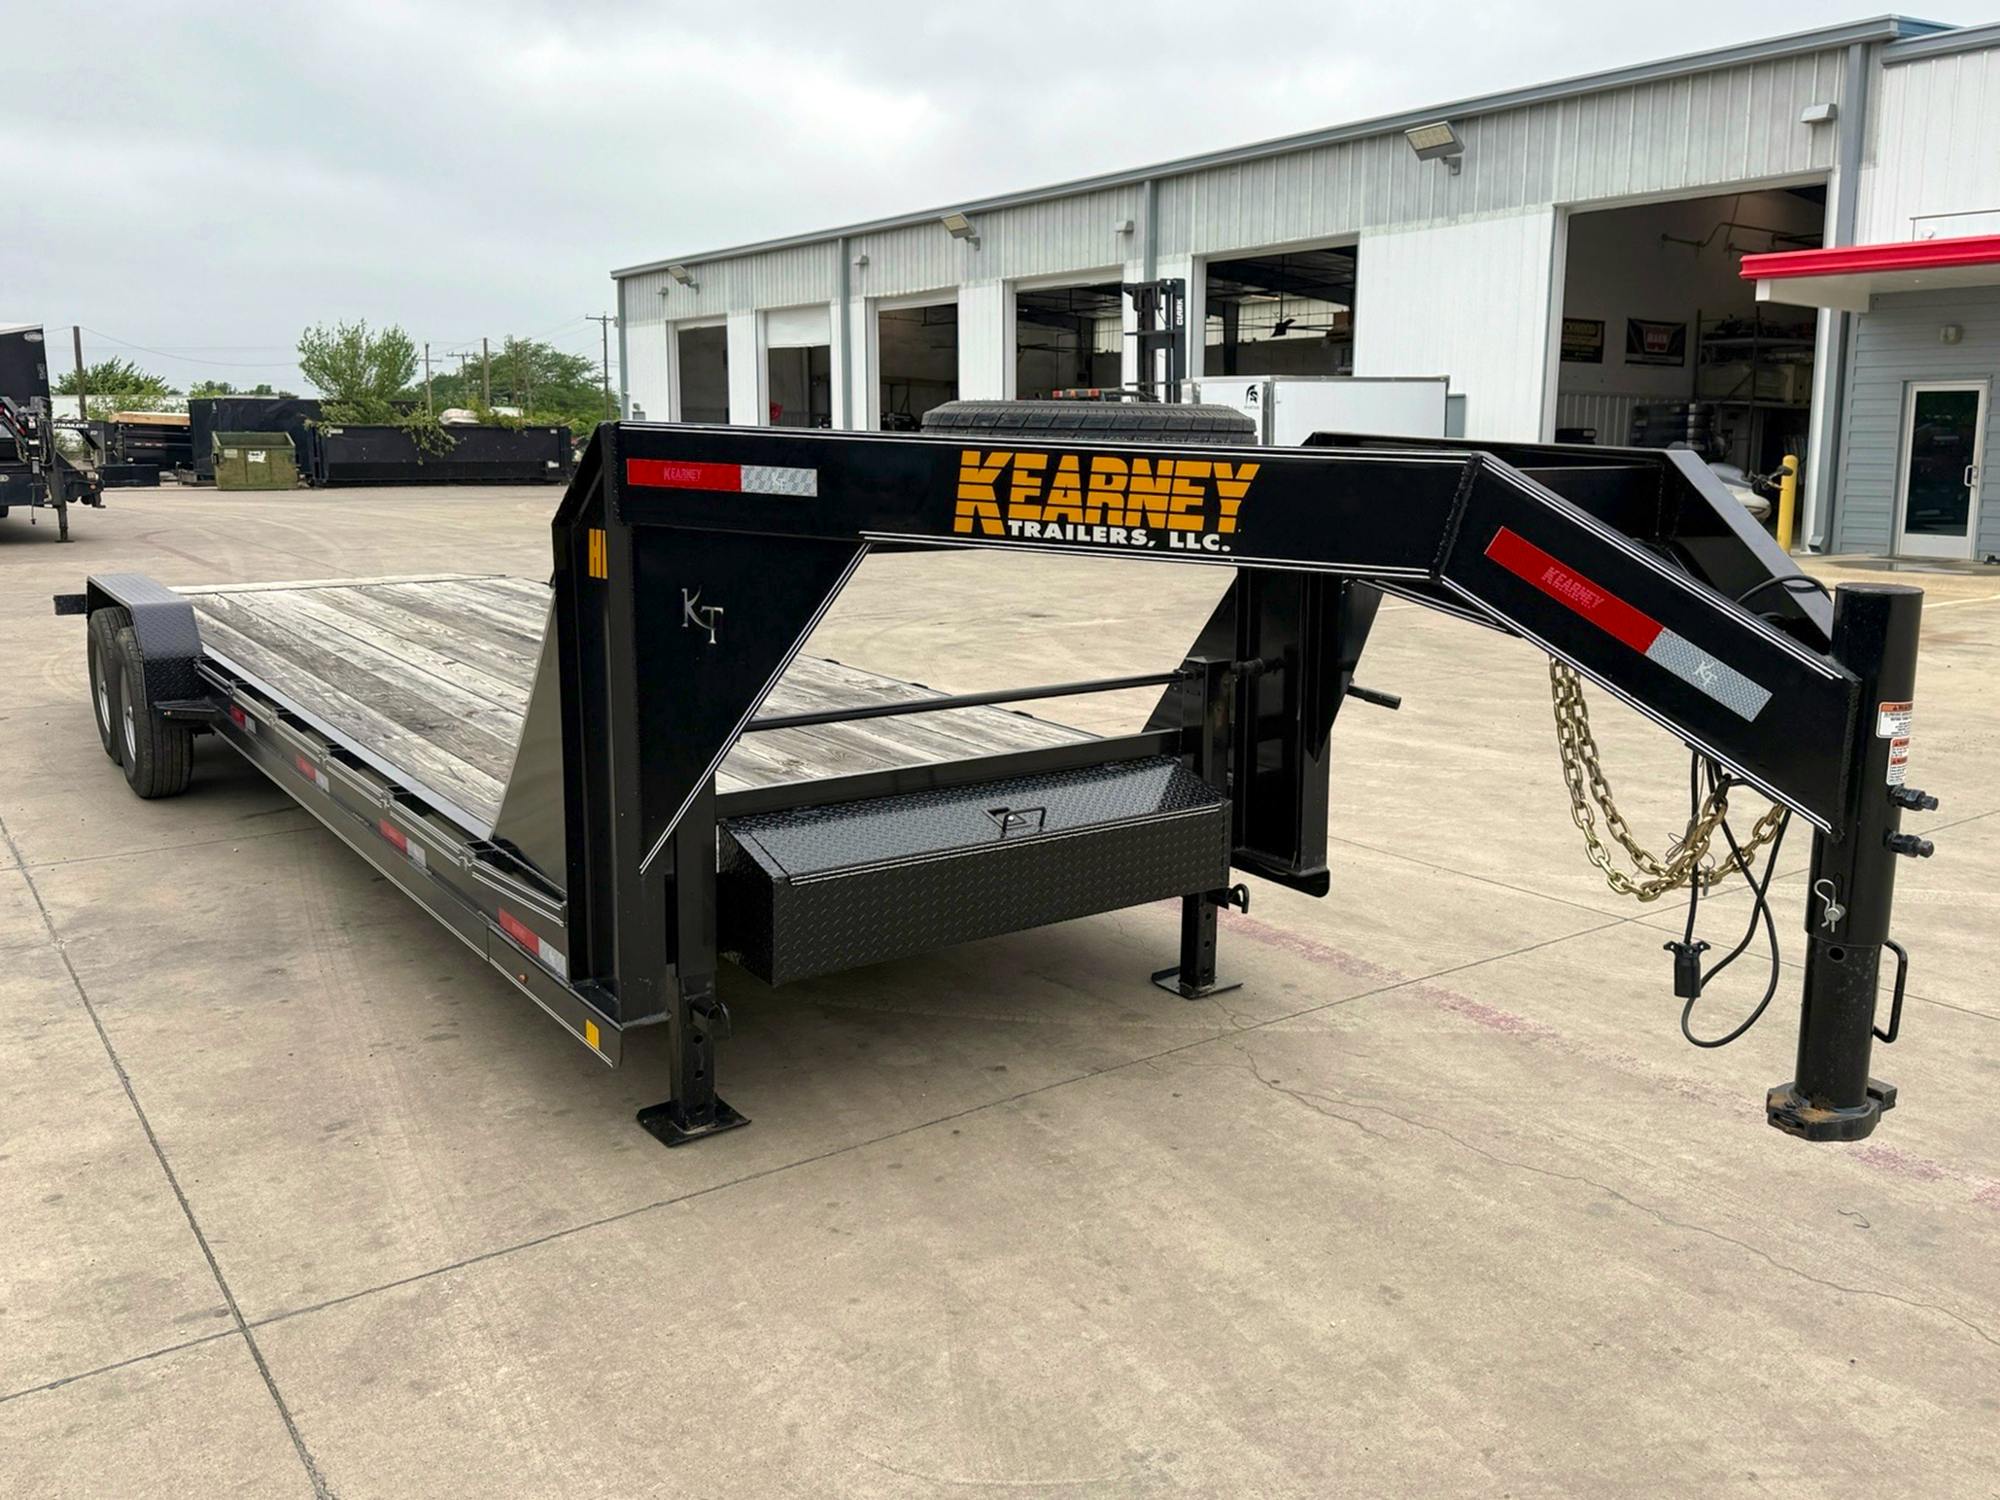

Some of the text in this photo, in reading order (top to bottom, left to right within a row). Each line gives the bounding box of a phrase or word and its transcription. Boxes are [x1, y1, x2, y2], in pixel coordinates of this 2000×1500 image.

[1176, 298, 1184, 326] CLARK
[663, 466, 702, 482] KEARNEY
[954, 450, 1261, 536] KEARNEY
[1007, 519, 1231, 552] TRAILERS, LLC.
[1541, 566, 1605, 609] KEARNEY
